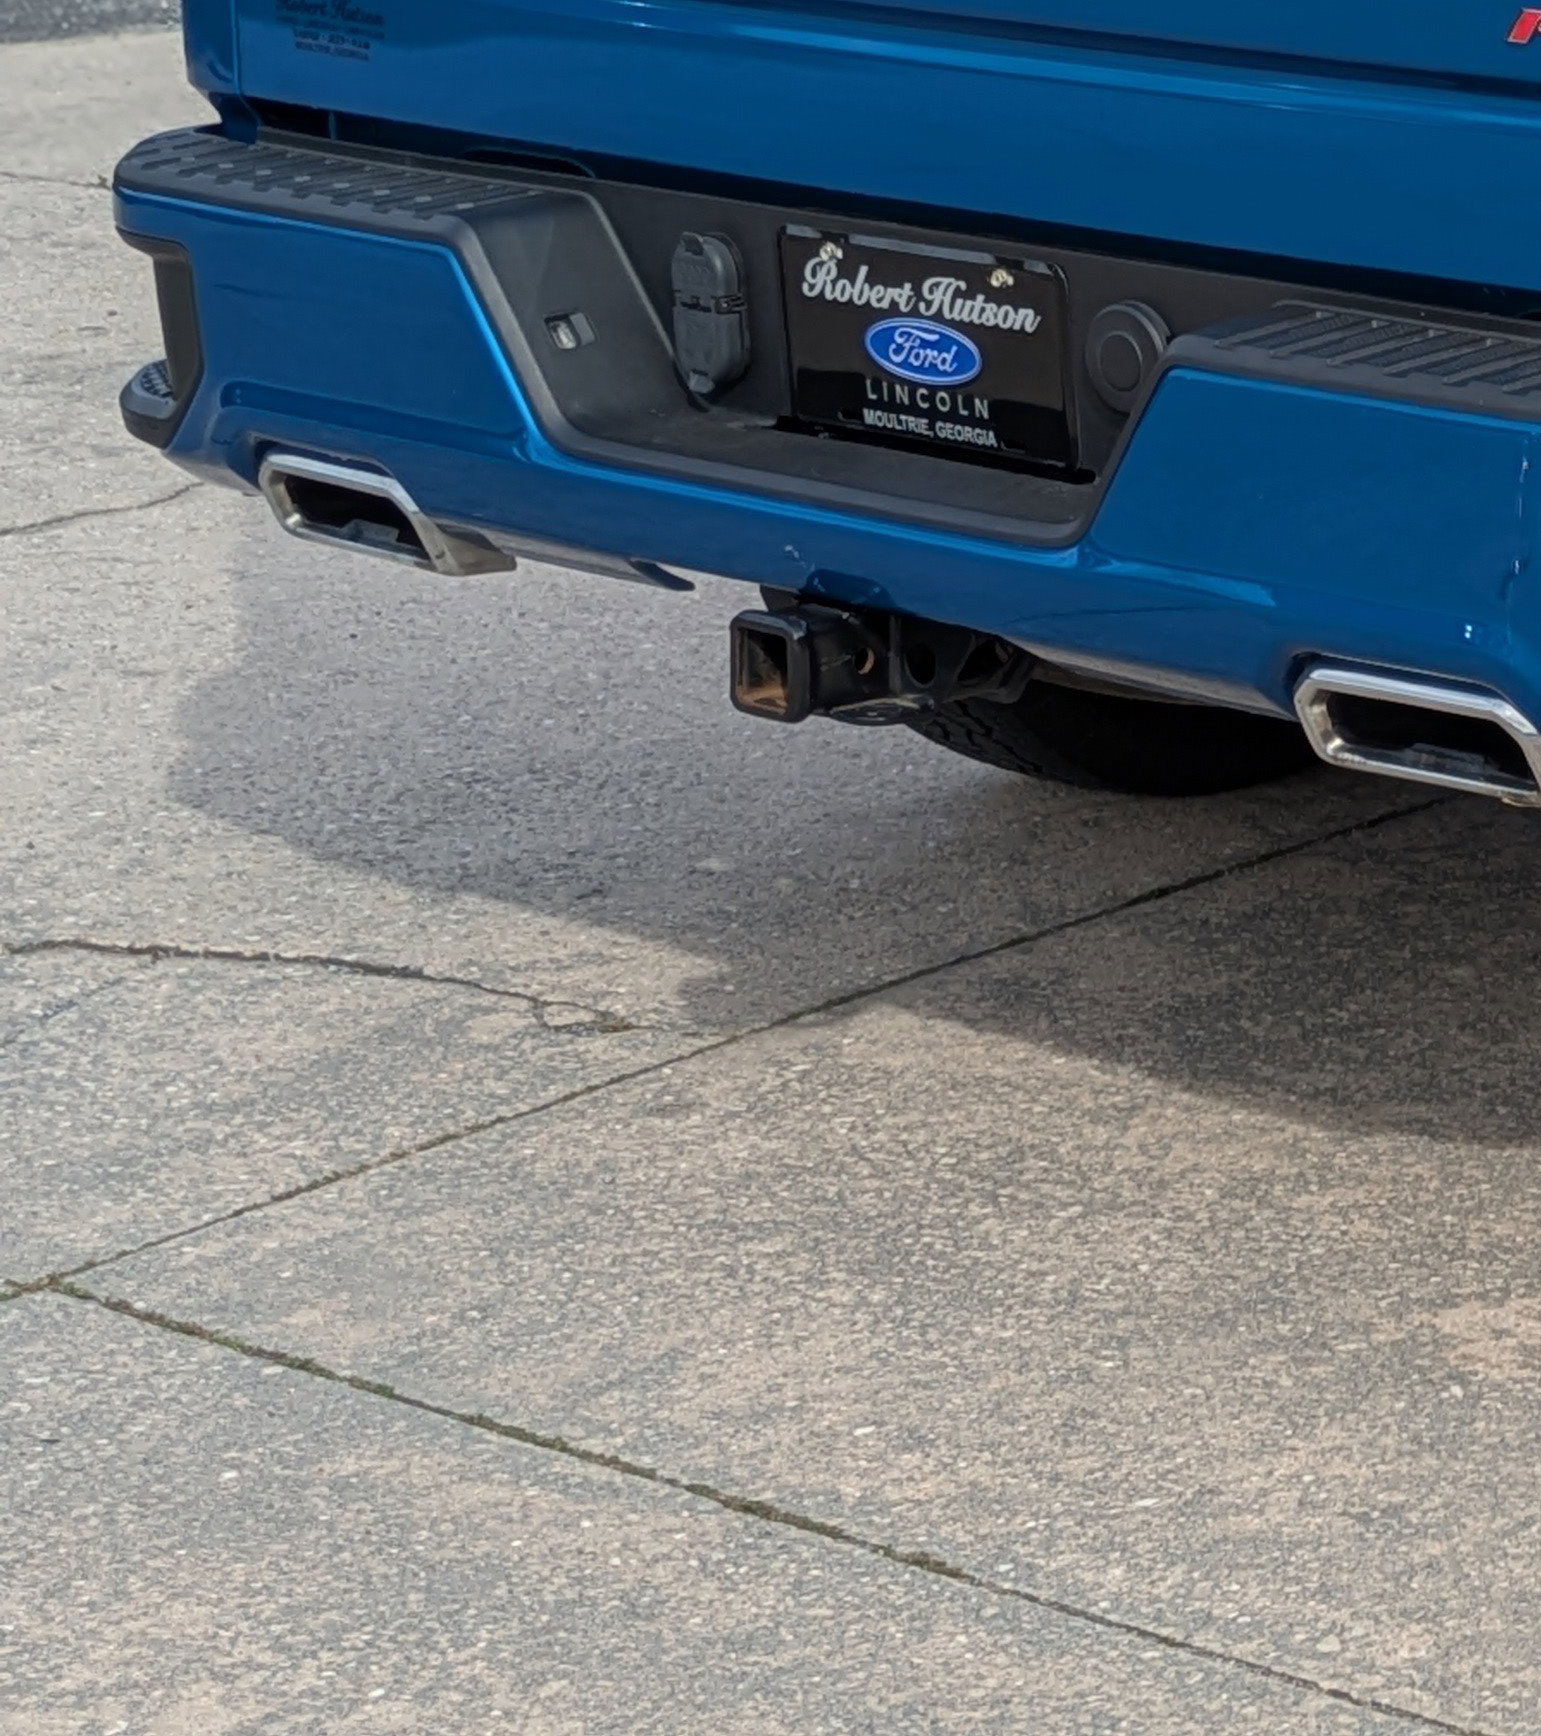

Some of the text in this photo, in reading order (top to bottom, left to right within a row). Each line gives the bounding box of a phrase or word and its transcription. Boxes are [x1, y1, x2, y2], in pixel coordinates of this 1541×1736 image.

[802, 256, 1042, 334] Robert Hutson
[888, 326, 958, 373] Ford
[865, 378, 990, 419] LINCOLN
[862, 408, 998, 448] MOULTRIE, GEORGIA
